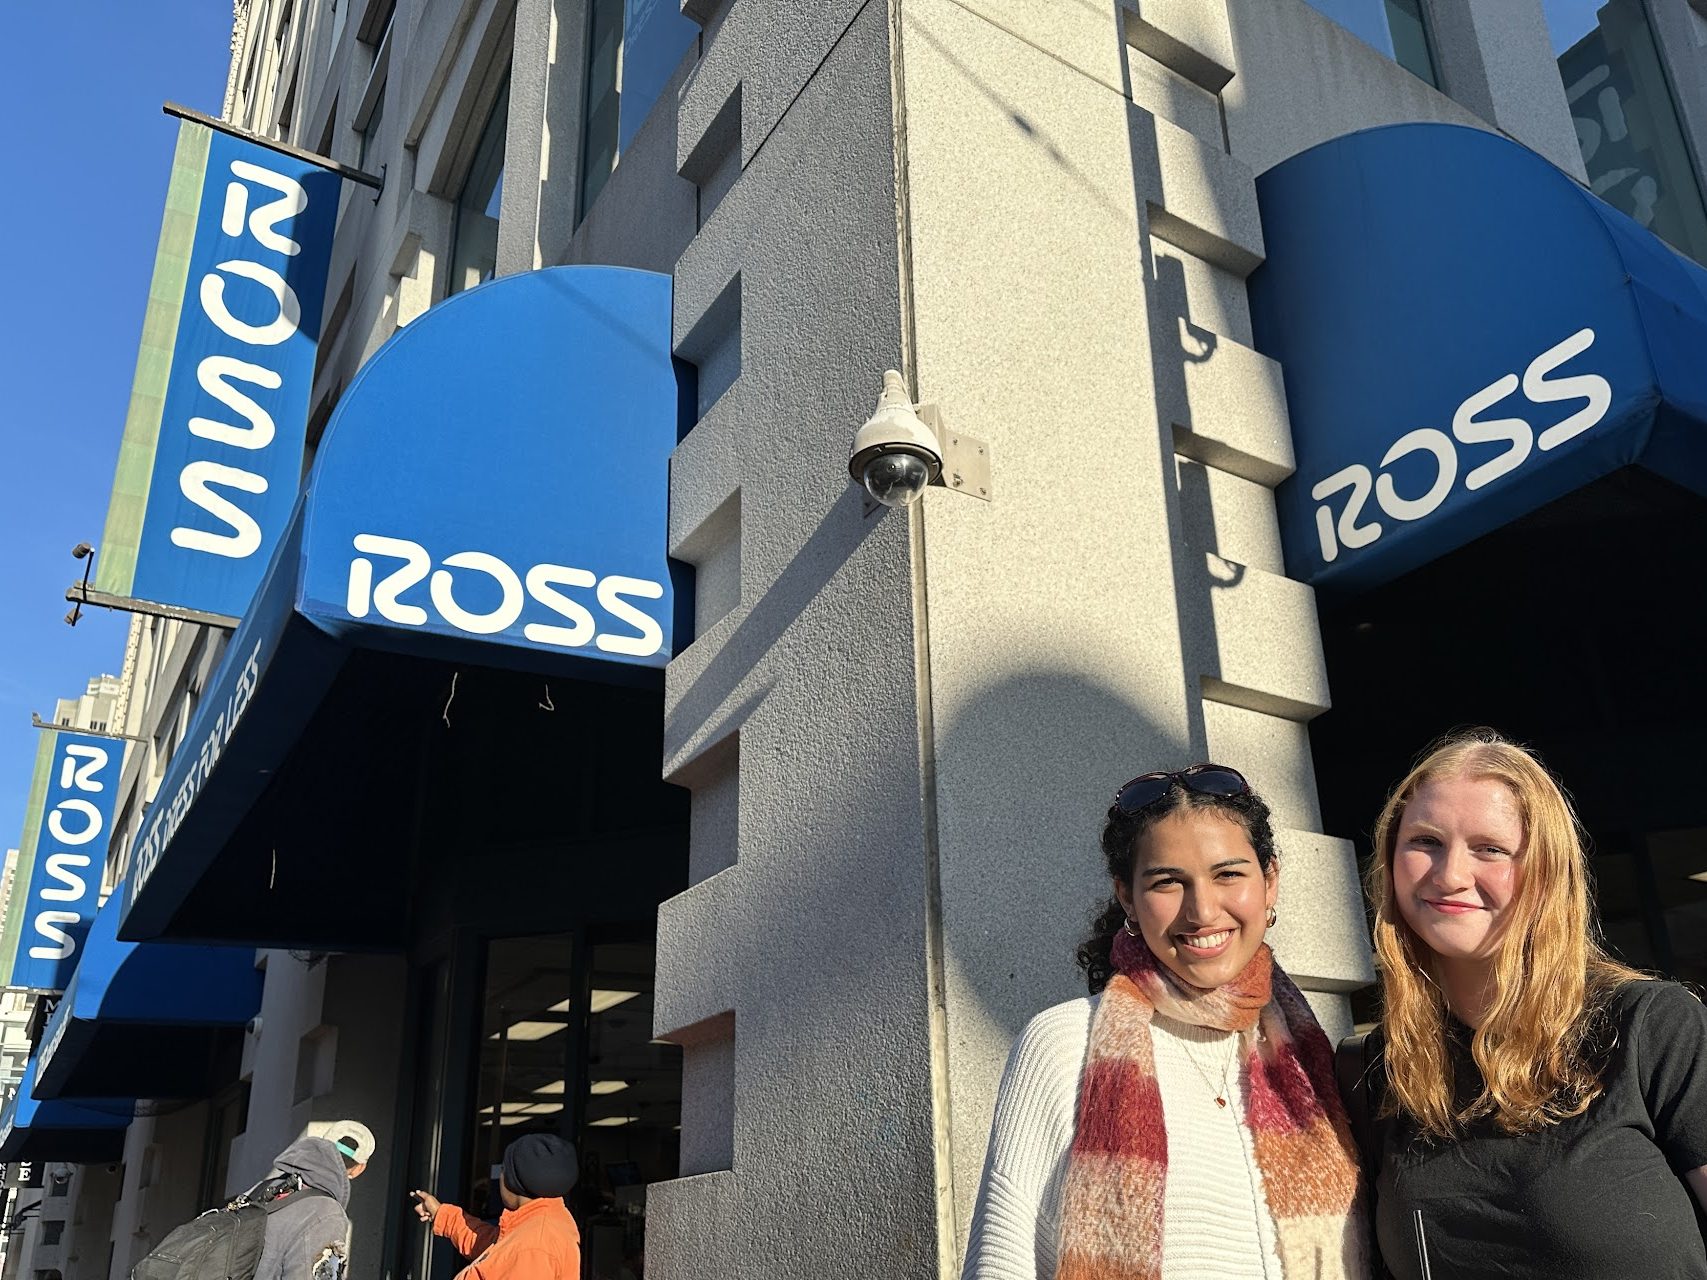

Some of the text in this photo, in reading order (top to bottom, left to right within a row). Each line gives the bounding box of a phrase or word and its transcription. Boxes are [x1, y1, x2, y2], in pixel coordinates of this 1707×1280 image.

[170, 159, 309, 559] ROSS
[1312, 327, 1612, 562] ROSS
[346, 533, 664, 656] ROSS
[29, 744, 109, 960] ROSS
[131, 638, 261, 907] ROSS DRESS FOR LESS
